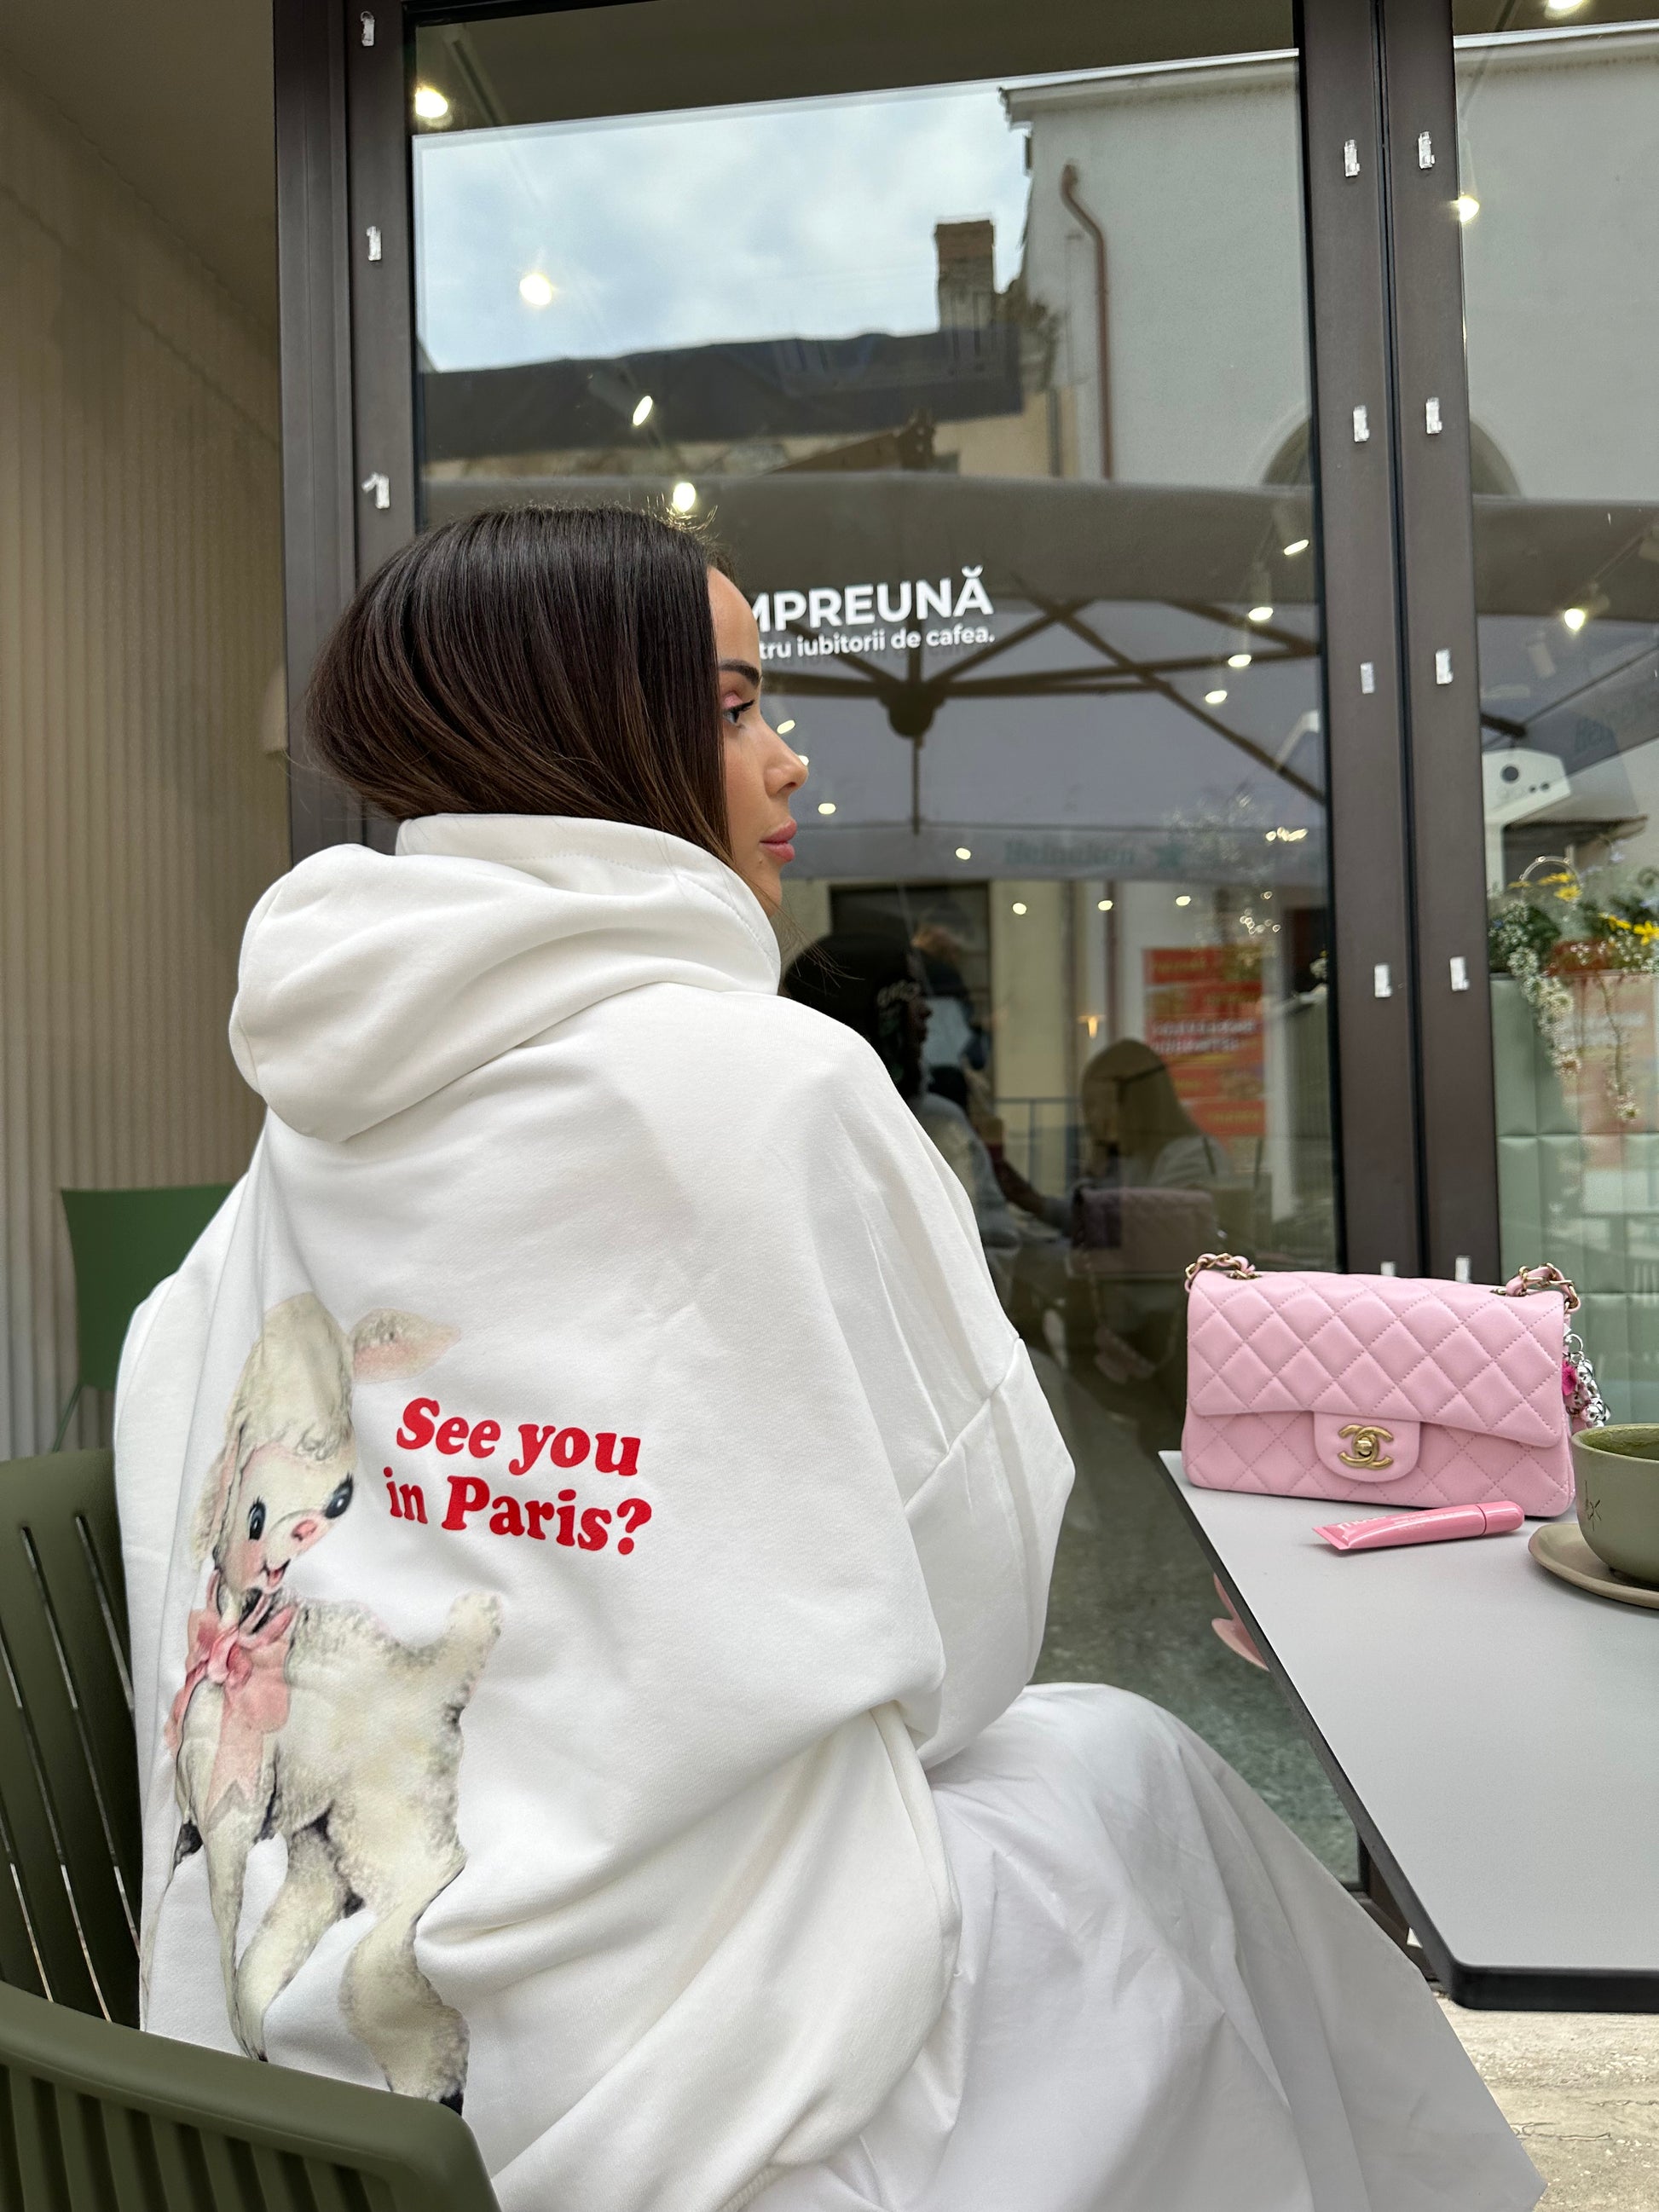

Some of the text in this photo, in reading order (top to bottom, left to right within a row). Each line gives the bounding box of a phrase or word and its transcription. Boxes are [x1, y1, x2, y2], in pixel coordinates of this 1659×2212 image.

[796, 628, 886, 658] iubitorii
[890, 627, 922, 649] de
[926, 622, 995, 647] cafea.
[396, 1397, 641, 1476] See you
[383, 1466, 652, 1556] in Paris?
